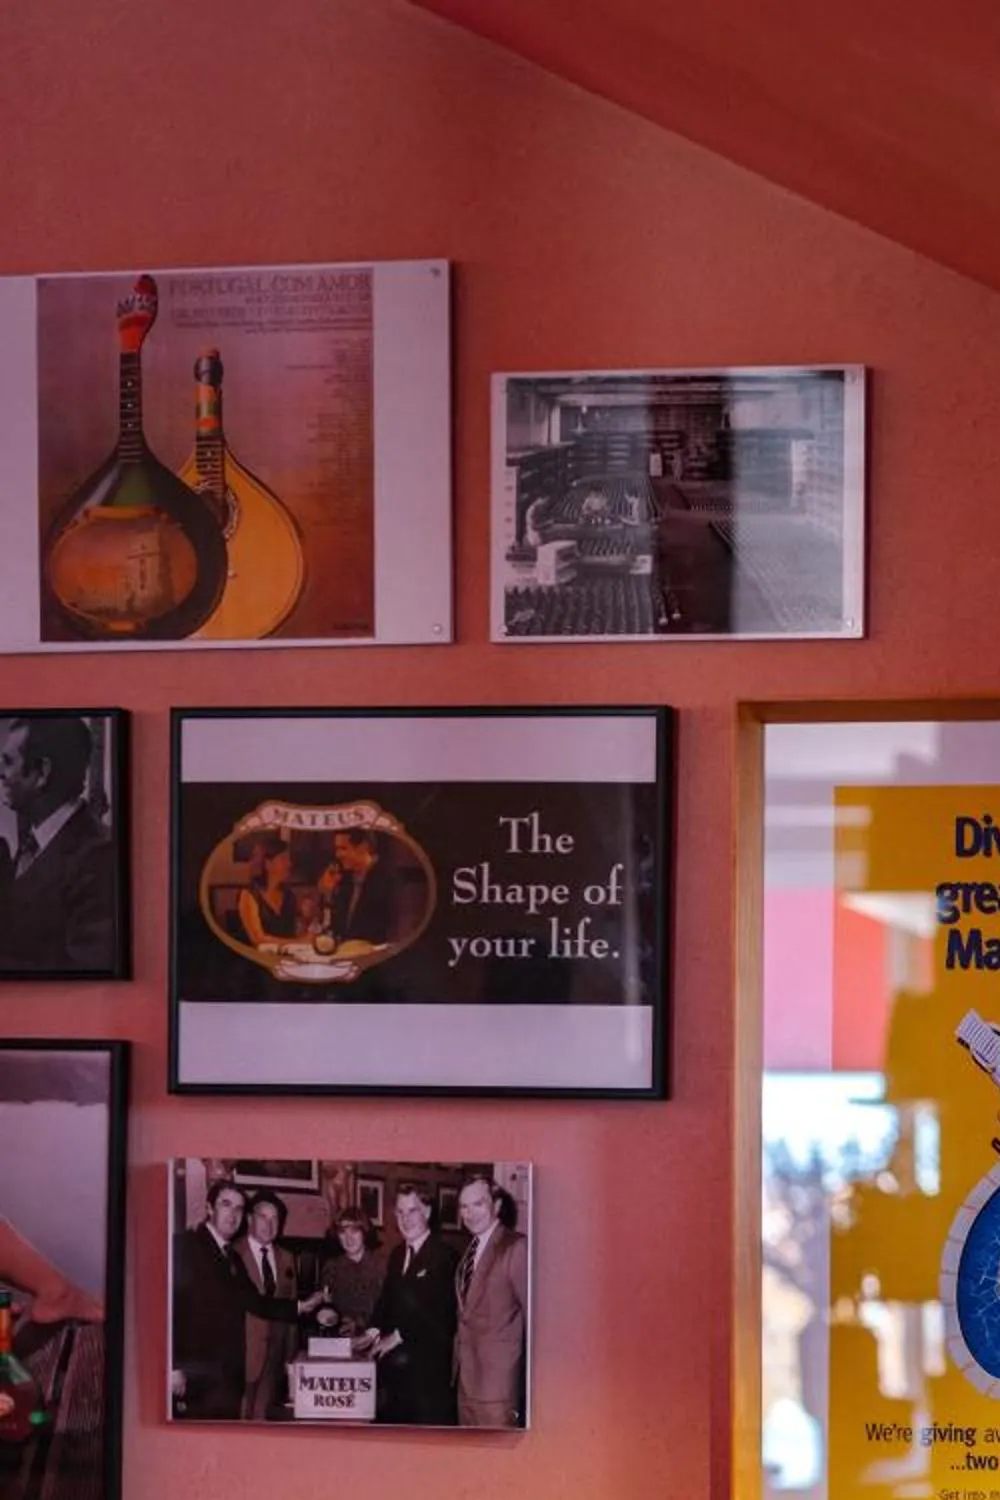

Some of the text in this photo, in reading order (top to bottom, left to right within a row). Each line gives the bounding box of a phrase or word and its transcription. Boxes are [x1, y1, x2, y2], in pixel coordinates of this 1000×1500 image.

[272, 807, 366, 826] MATEUS
[499, 811, 574, 854] The
[452, 862, 624, 916] Shape of
[447, 916, 621, 967] your life.
[299, 1376, 371, 1392] MATEUS
[864, 1422, 913, 1442] We're
[920, 1423, 977, 1447] giving
[950, 1453, 999, 1471] ...two
